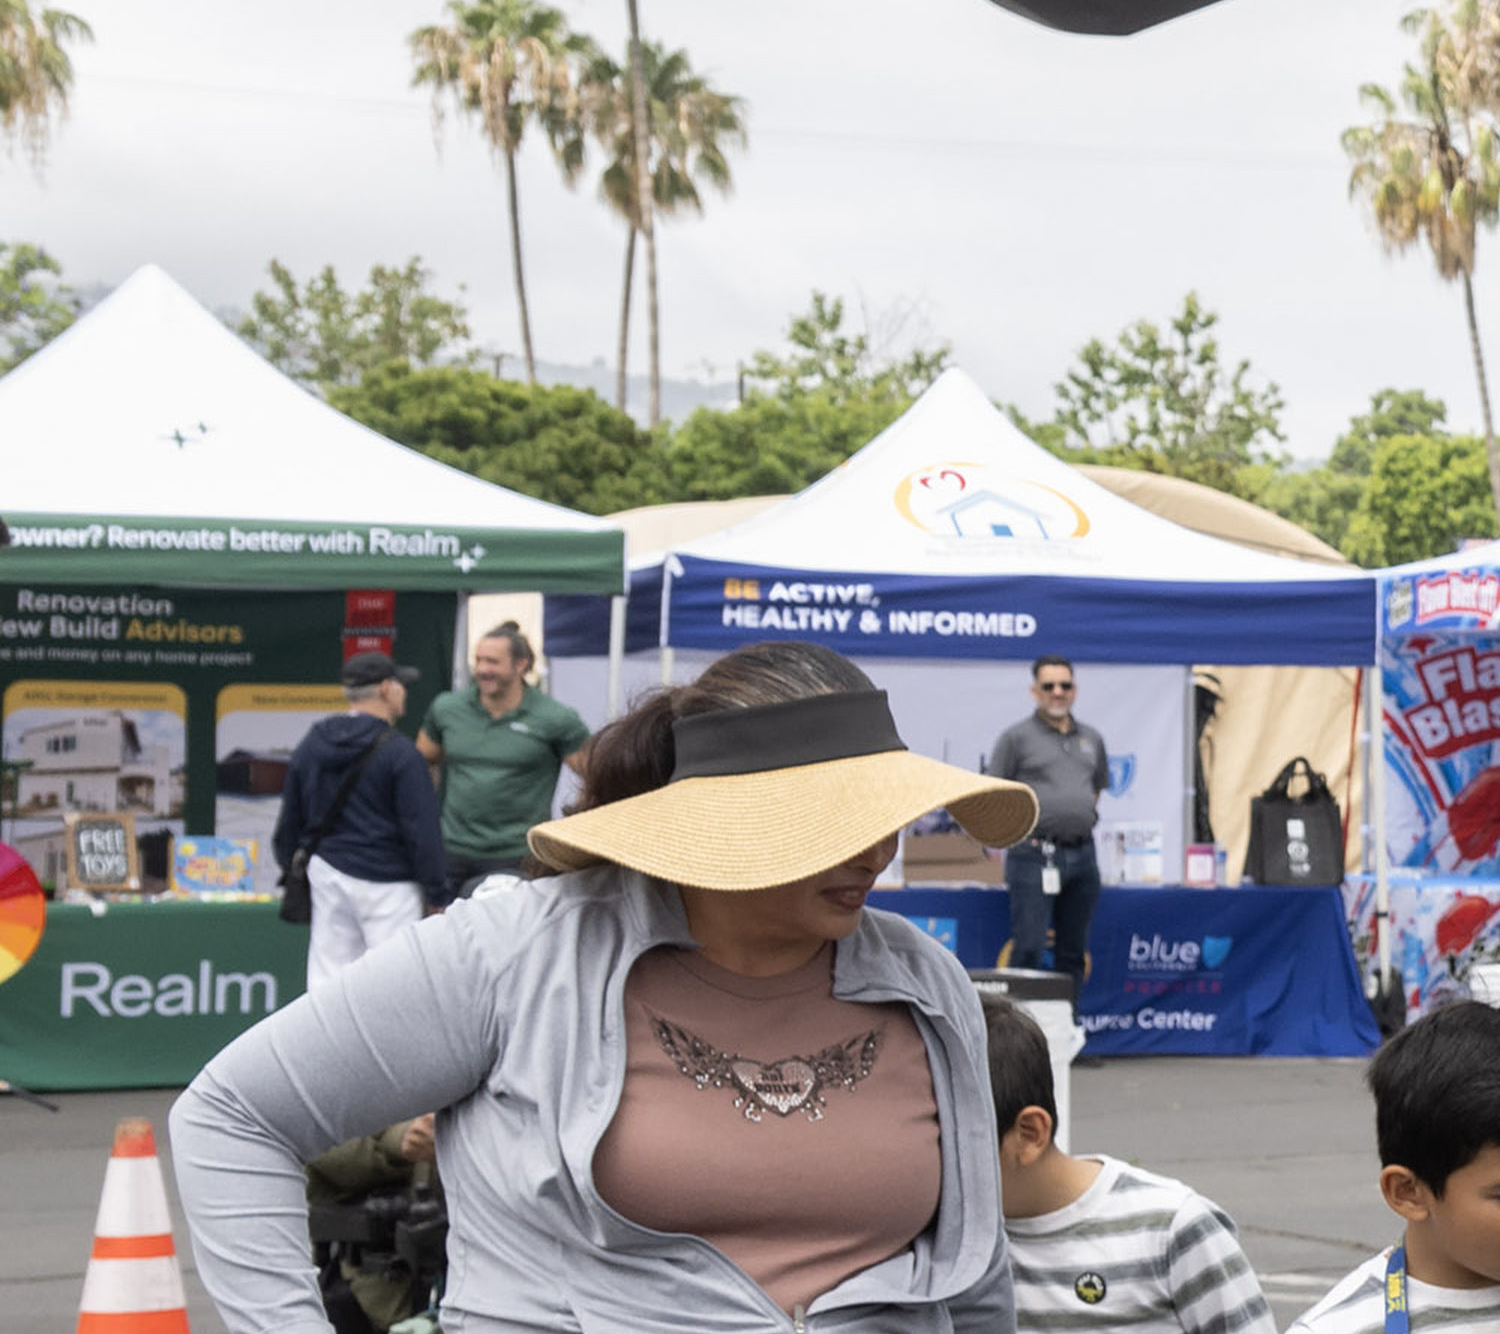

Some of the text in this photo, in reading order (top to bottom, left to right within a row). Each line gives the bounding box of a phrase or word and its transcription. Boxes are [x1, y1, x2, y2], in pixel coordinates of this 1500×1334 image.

[107, 526, 224, 551] Renovate
[230, 527, 304, 552] better
[309, 530, 363, 553] with
[369, 527, 459, 557] Realm
[17, 589, 173, 616] Renovation
[724, 577, 880, 607] BE ACTIVE,
[0, 616, 244, 644] ew Build Advisors
[723, 605, 1037, 637] HEALTHY & INFORMED
[156, 649, 196, 663] home
[200, 651, 253, 667] project
[79, 828, 125, 853] FREE
[80, 854, 127, 876] TOYS
[1129, 933, 1200, 962] blue
[60, 959, 277, 1019] Realm
[1137, 1007, 1217, 1032] Center
